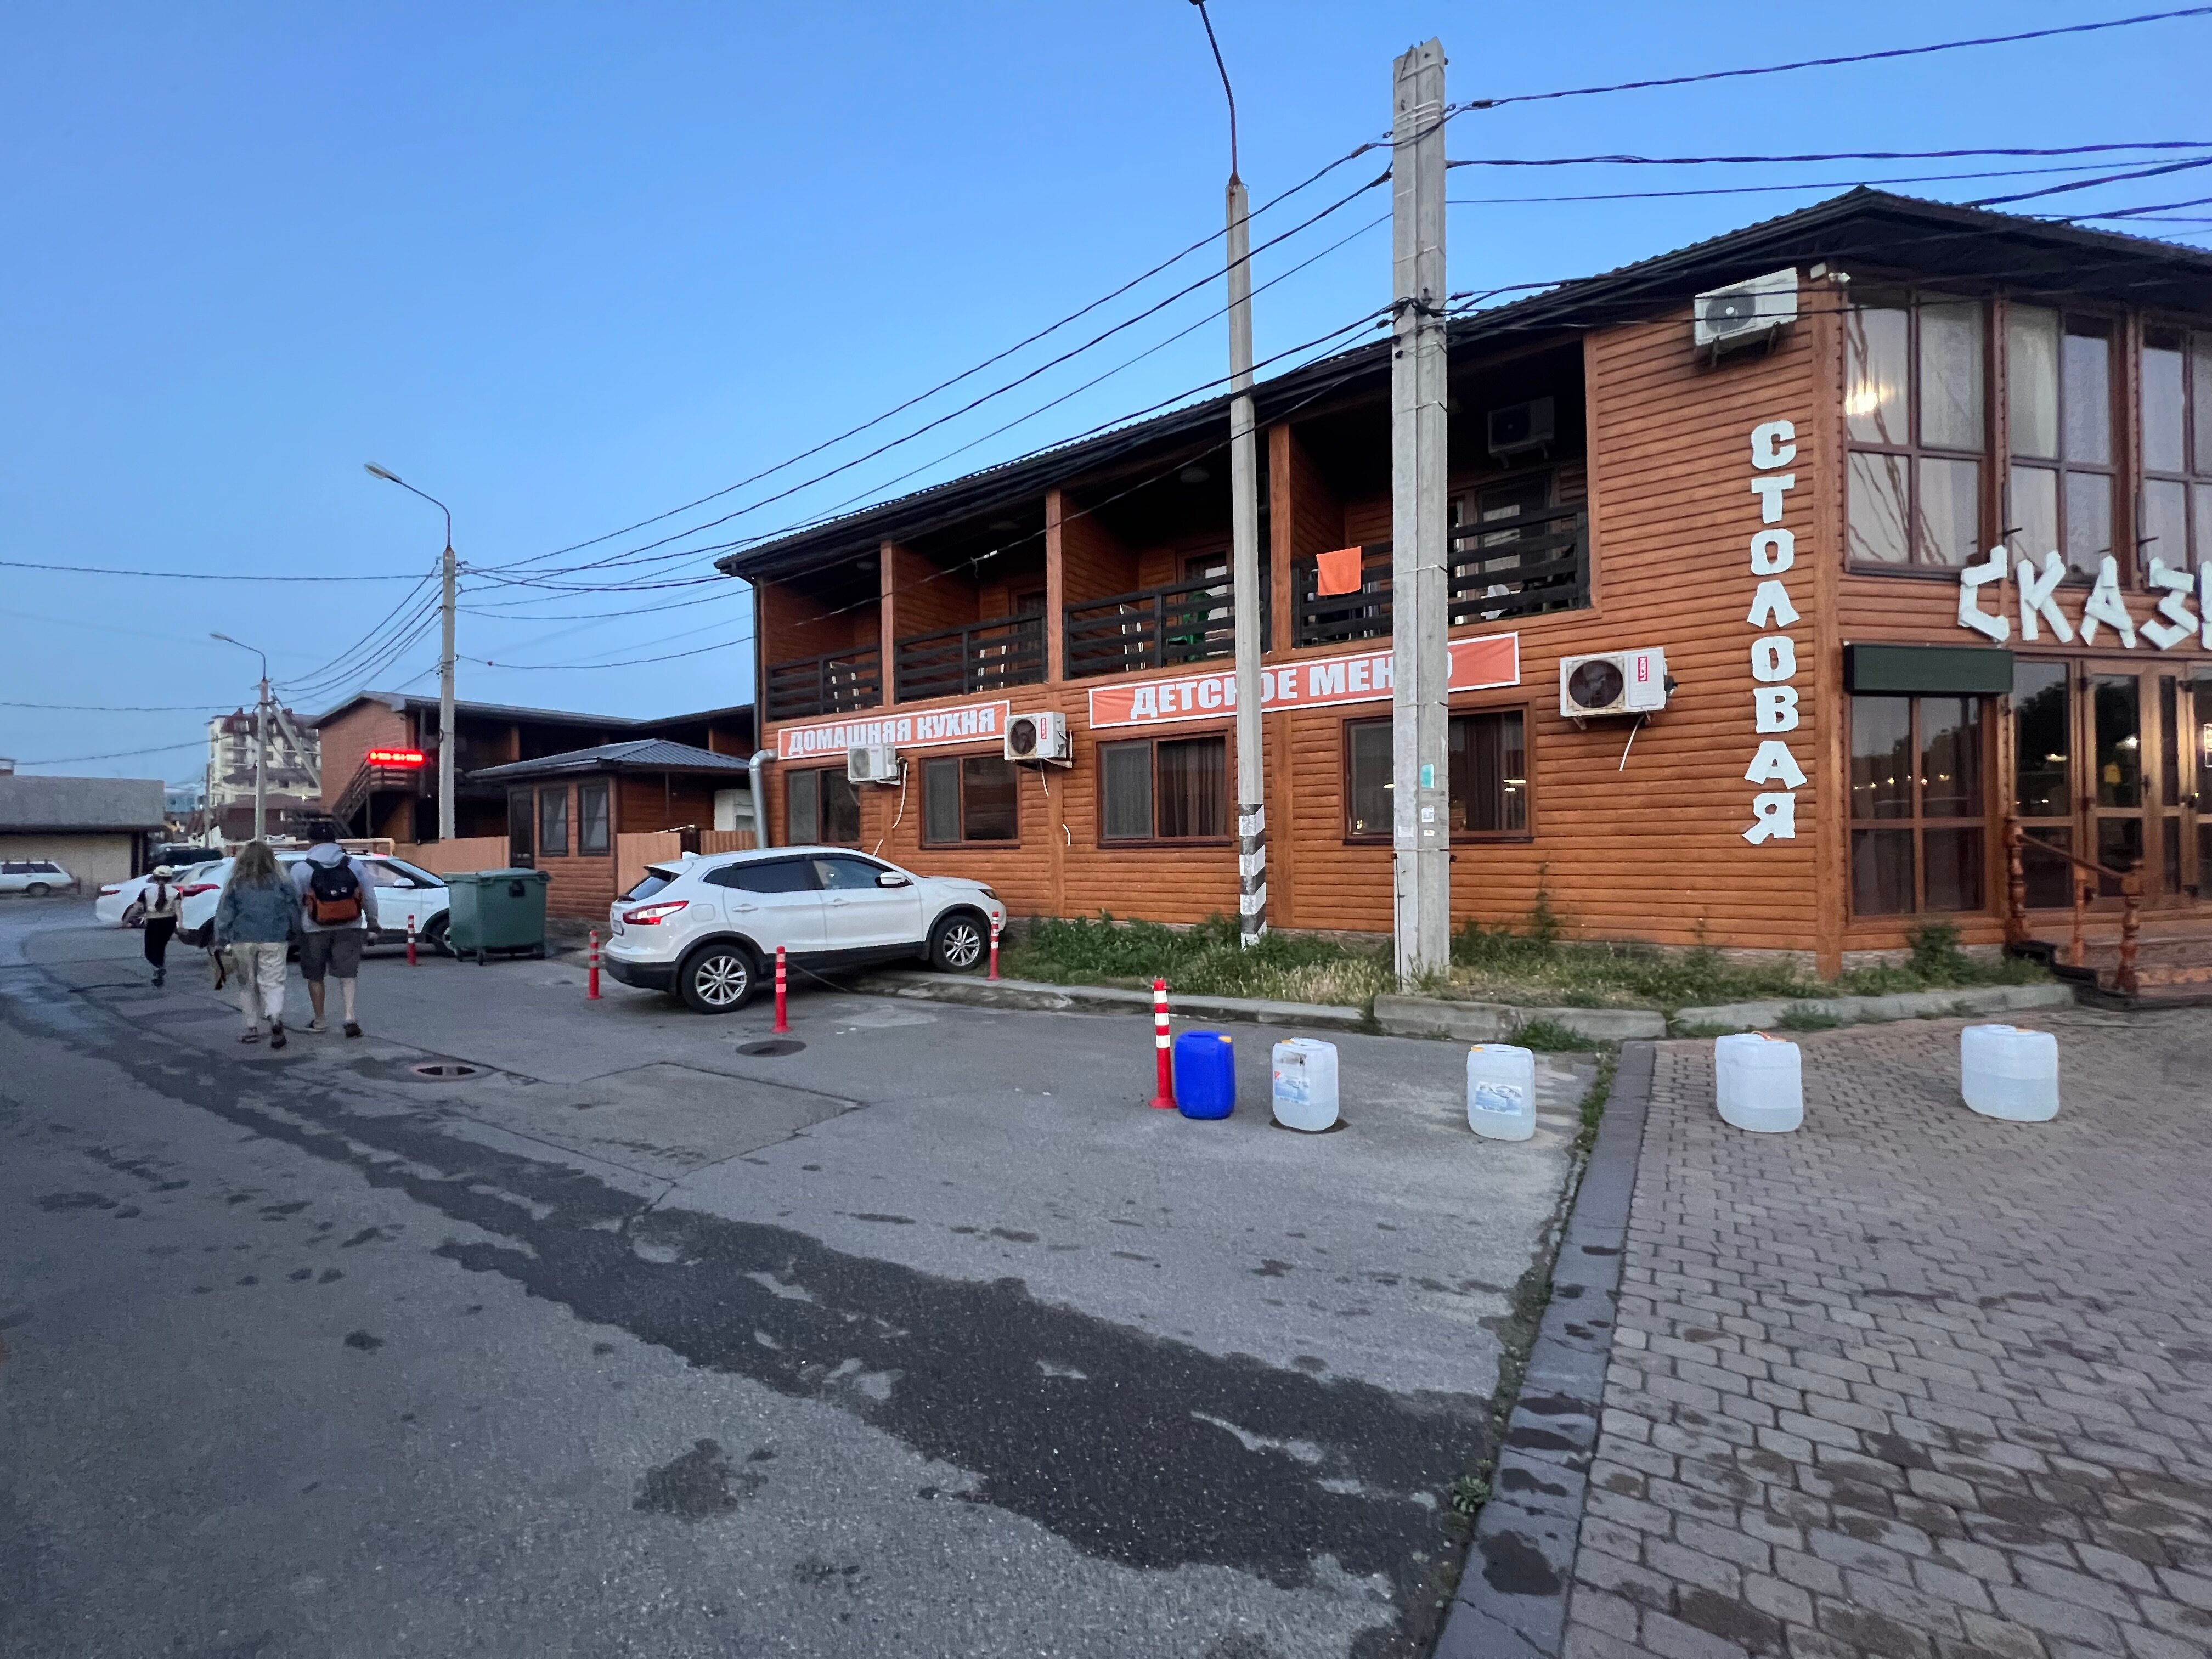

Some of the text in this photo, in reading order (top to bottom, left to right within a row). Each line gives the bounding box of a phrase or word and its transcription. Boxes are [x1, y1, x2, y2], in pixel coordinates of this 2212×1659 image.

[1742, 420, 1808, 845] СТОЛОВАЯ
[1958, 545, 2212, 651] СКАЗ
[1309, 651, 1452, 697] МЕН
[788, 708, 995, 756] ДОМАШНЯЯ КУХНЯ
